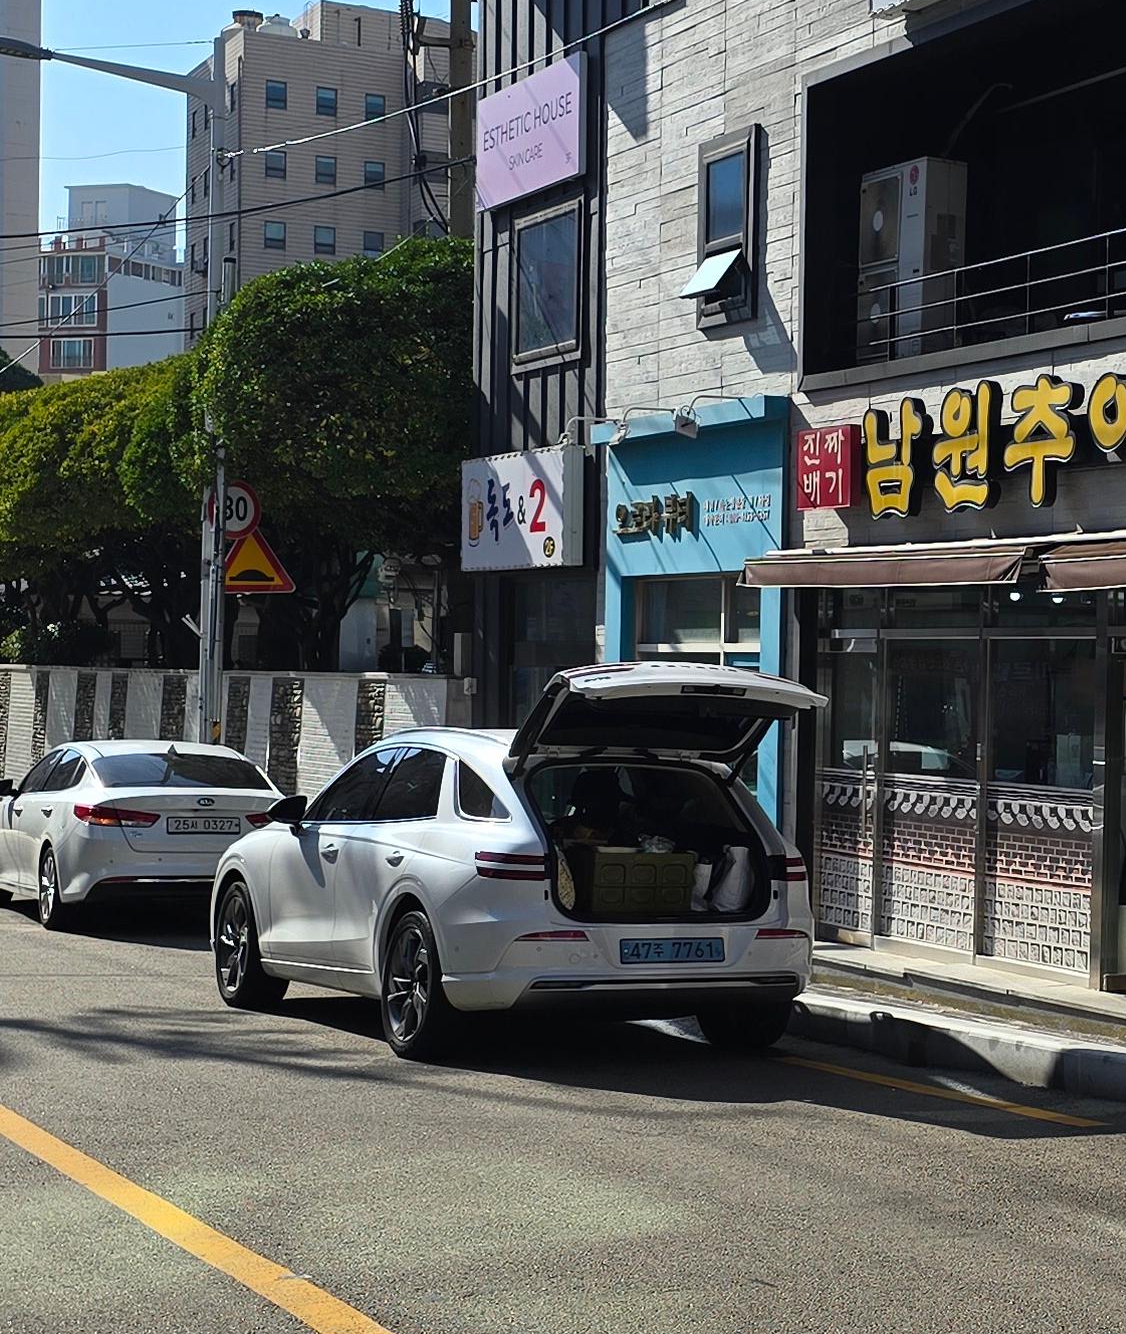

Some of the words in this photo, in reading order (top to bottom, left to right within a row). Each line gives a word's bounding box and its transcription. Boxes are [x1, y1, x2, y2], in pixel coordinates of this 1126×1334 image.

[483, 111, 531, 152] ESTHETIC
[533, 92, 573, 129] HOUSE
[508, 148, 525, 171] SKIN
[525, 142, 544, 164] CARE
[803, 429, 845, 466] 진짜
[803, 468, 843, 505] 배기
[204, 820, 233, 831] 0327
[672, 942, 713, 958] 7761
